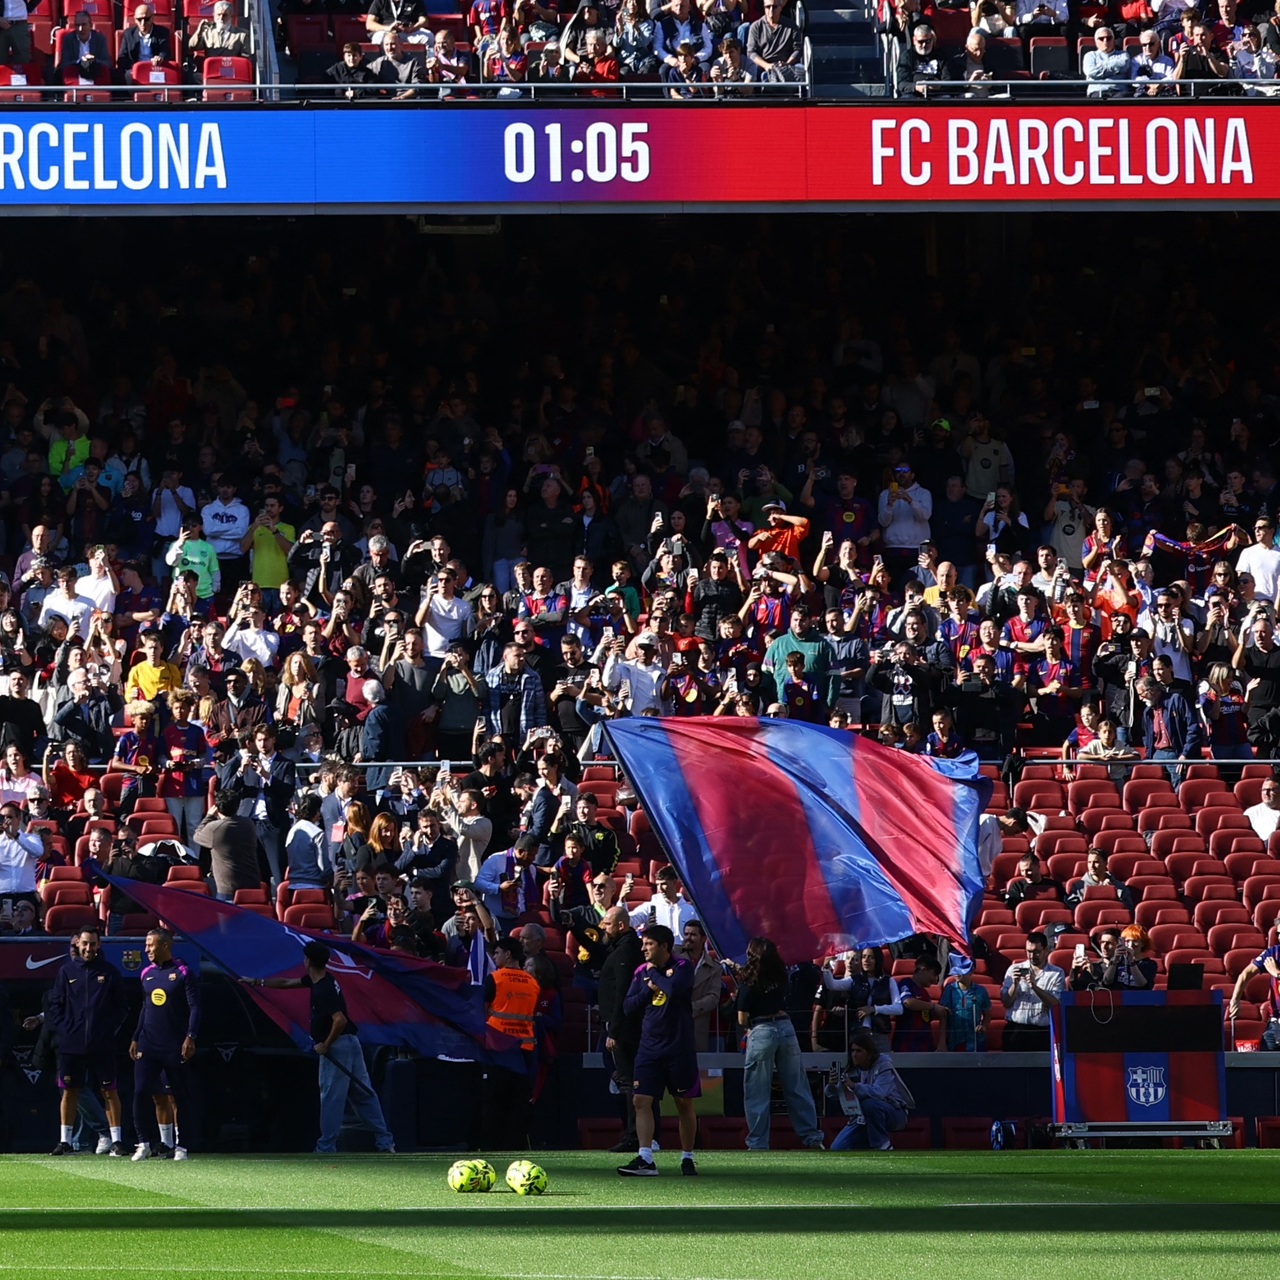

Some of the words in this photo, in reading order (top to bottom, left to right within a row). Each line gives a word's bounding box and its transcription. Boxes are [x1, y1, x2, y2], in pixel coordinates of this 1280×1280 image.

[504, 121, 650, 183] 01:05
[871, 118, 931, 186] FC
[948, 117, 1253, 185] BARCELONA
